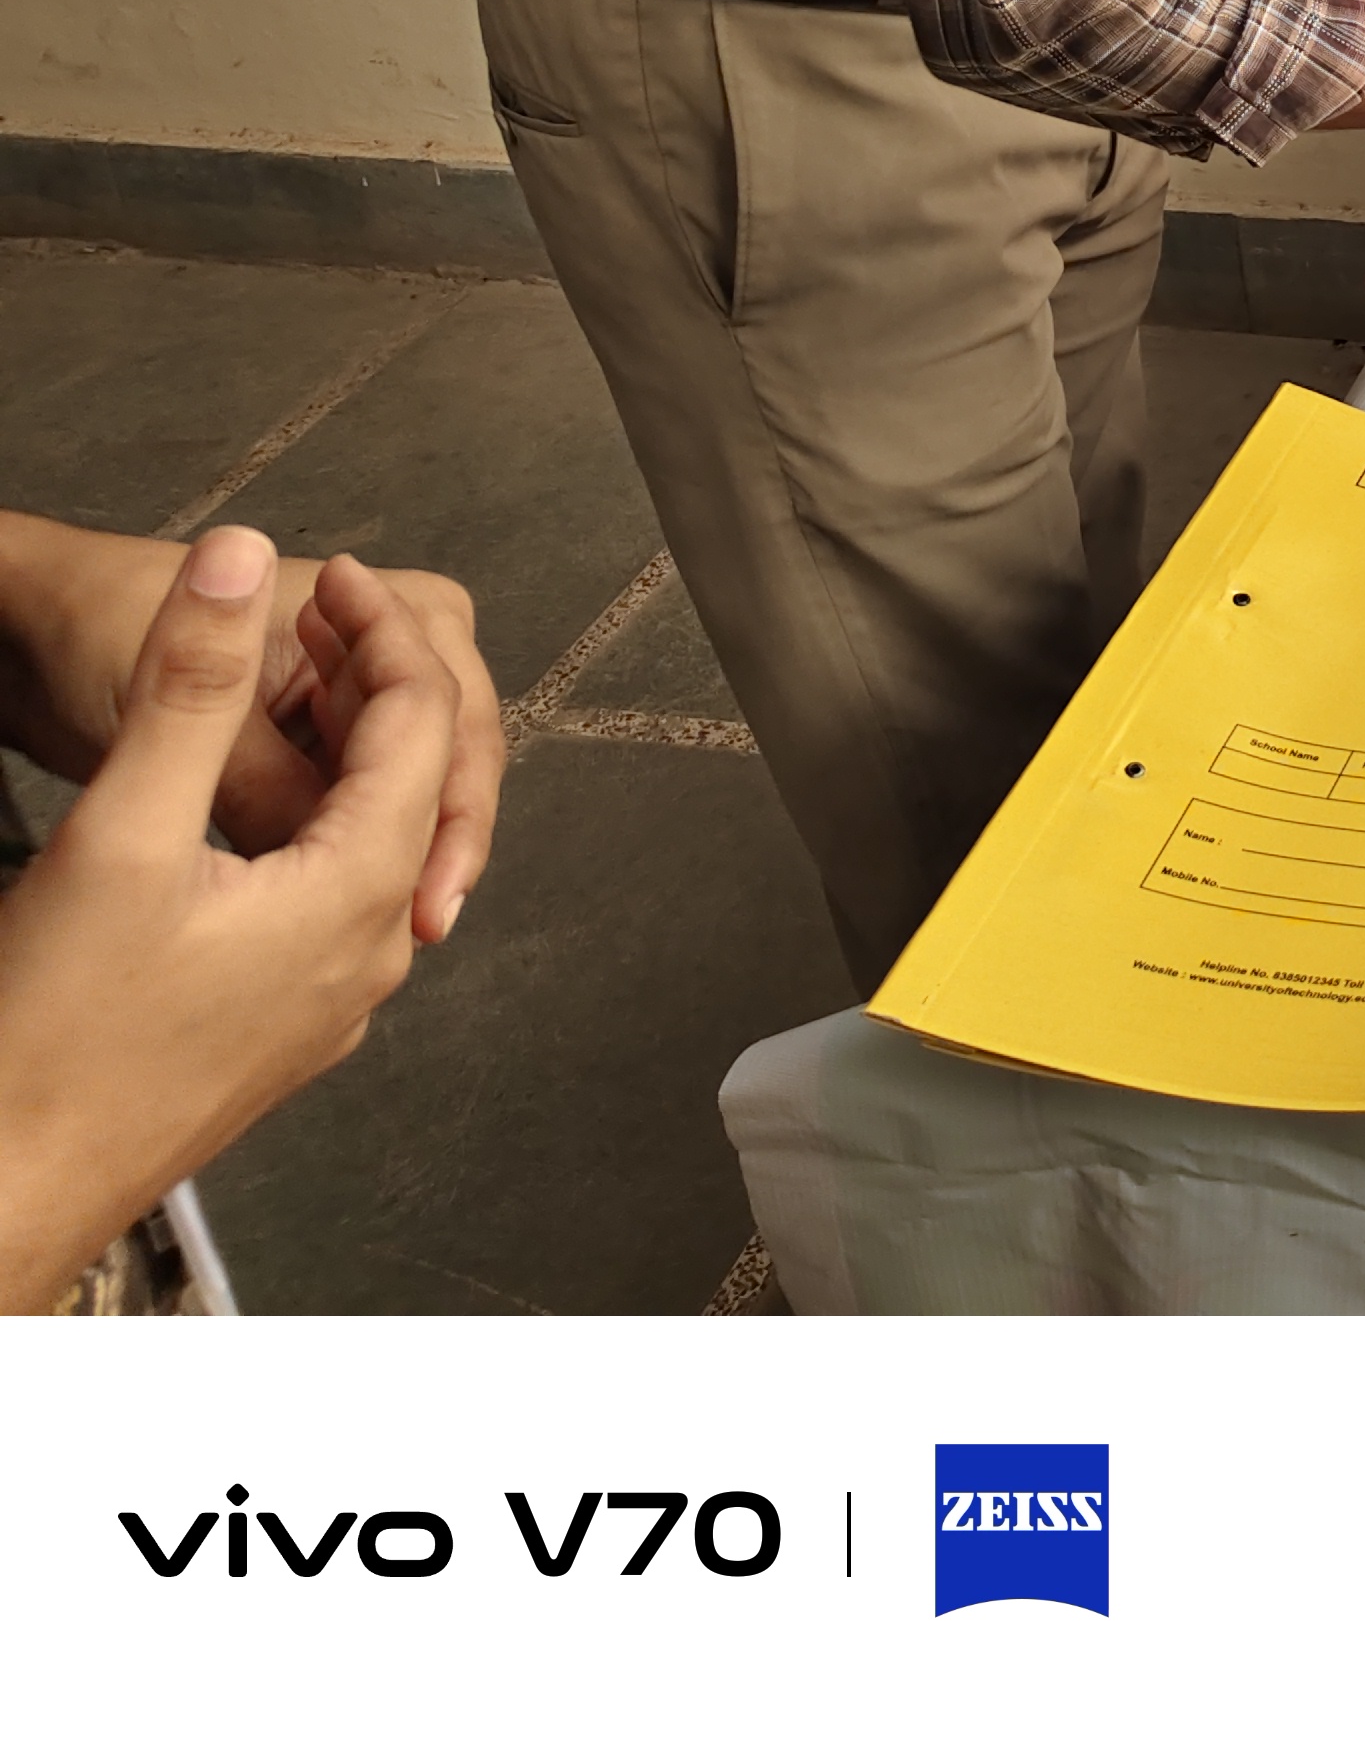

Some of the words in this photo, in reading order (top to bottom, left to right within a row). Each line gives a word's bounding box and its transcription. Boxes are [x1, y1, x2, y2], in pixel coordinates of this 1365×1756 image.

[1250, 739, 1287, 754] School
[1289, 750, 1319, 761] Name
[1184, 829, 1215, 843] Name
[1161, 866, 1198, 882] Mobile
[1201, 876, 1219, 888] No.
[1133, 959, 1179, 977] Website
[1200, 959, 1247, 976] Helpline
[1250, 968, 1269, 979] No.
[1344, 980, 1364, 988] Toll
